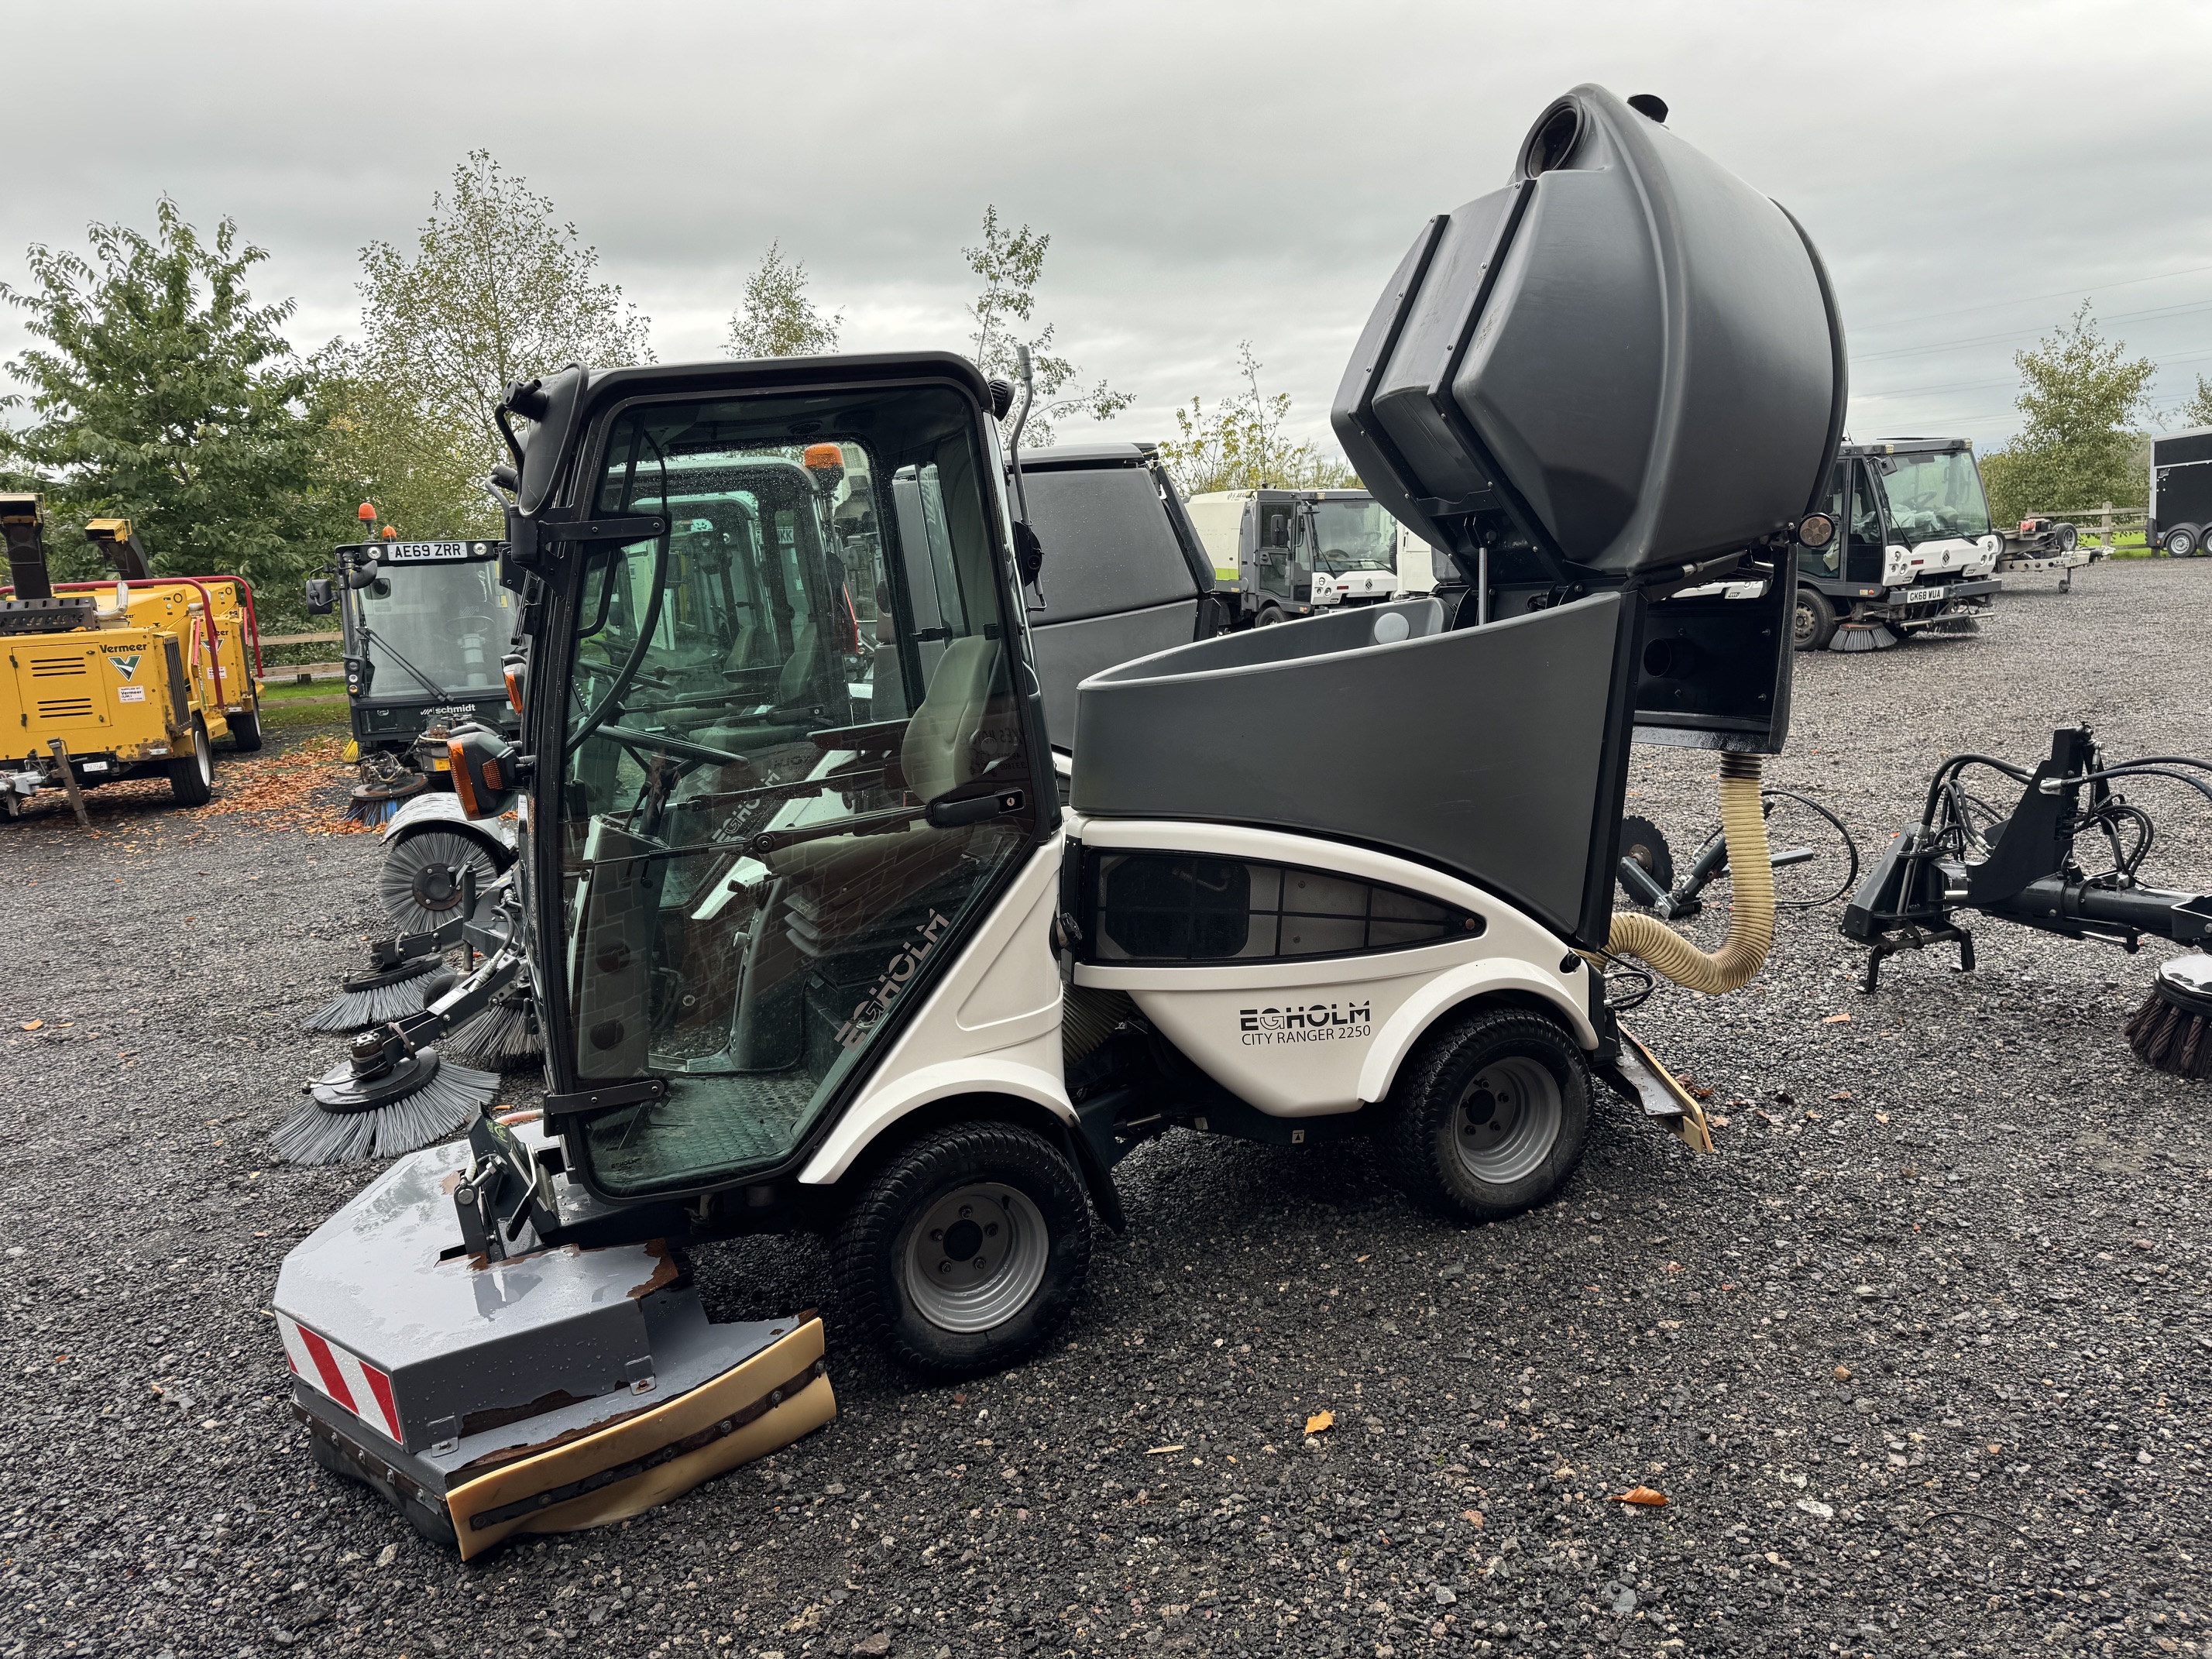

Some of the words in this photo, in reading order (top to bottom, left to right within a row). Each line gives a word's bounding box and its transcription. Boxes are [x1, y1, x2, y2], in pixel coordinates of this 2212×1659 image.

[395, 544, 431, 558] AE69
[434, 544, 461, 556] ZRR
[1909, 591, 1927, 601] GK68
[1928, 589, 1941, 599] WUA
[99, 643, 147, 653] Vermeer
[435, 703, 476, 714] schmidt
[834, 908, 950, 1052] EGHOLM
[1240, 1000, 1371, 1031] EGHOLM
[1242, 1032, 1273, 1046] CITY
[1277, 1028, 1334, 1044] RANGER
[1338, 1025, 1371, 1039] 2250
